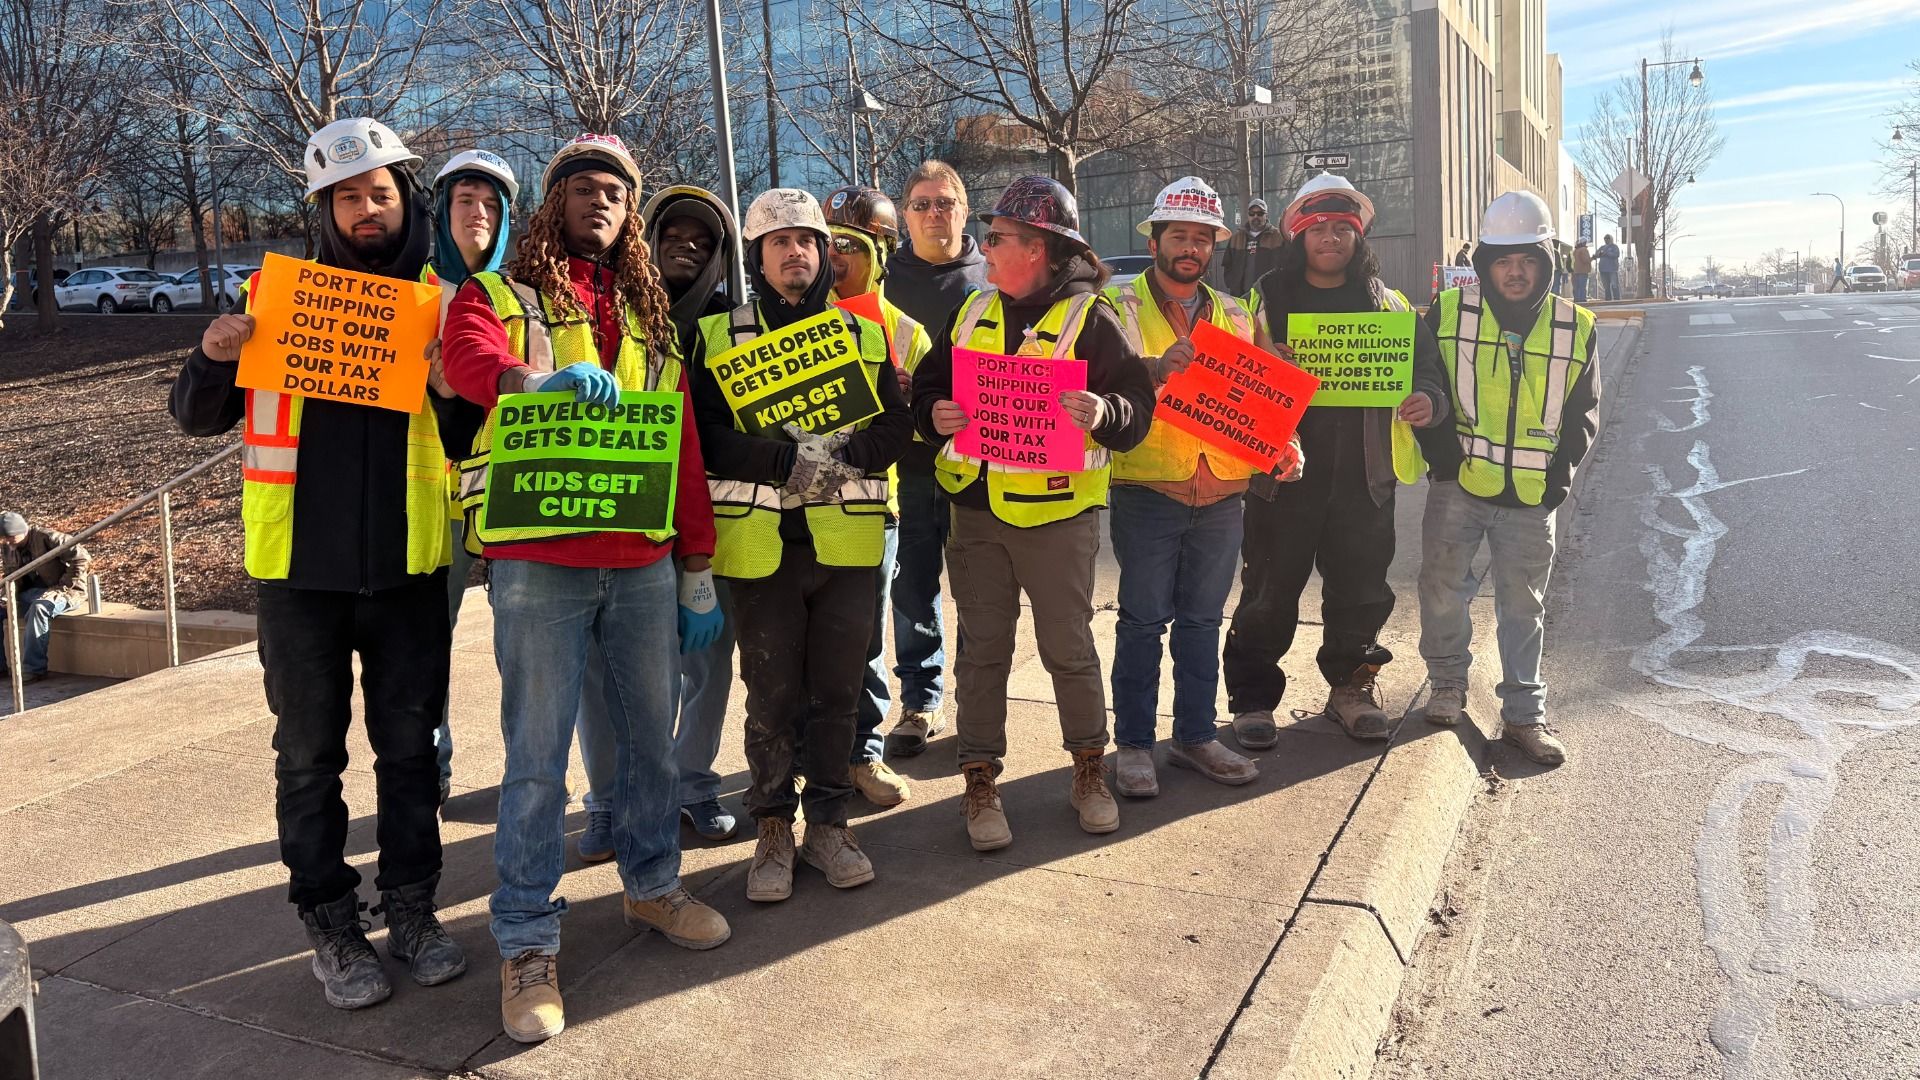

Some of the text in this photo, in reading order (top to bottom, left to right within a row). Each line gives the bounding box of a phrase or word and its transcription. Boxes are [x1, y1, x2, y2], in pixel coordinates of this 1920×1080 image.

[1250, 106, 1264, 117] W.
[1266, 104, 1292, 116] Davis
[1180, 188, 1206, 196] PROUD
[298, 268, 399, 301] PORT KC:
[293, 290, 396, 321] SHIPPING
[292, 312, 390, 342] OUT OUR
[1317, 324, 1382, 335] PORT KC:
[276, 331, 397, 364] JOBS WITH
[715, 318, 844, 382] DEVELOPERS
[1290, 338, 1411, 349] TAKING MILLIONS
[285, 353, 382, 381] OUR TAX
[731, 339, 848, 398] GETS DEALS
[977, 357, 1050, 377] PORT KC:
[1234, 353, 1270, 378] TAX
[1335, 353, 1355, 363] KC
[1358, 352, 1409, 363] GIVING
[1194, 352, 1295, 409] ABATEMENTS
[1334, 366, 1372, 378] JOBS
[1374, 366, 1394, 377] TO
[283, 374, 380, 401] DOLLARS
[977, 375, 1050, 395] SHIPPING
[1372, 381, 1403, 391] ELSE
[500, 401, 677, 427] DEVELOPERS
[755, 377, 847, 428] KIDS GET
[979, 392, 1048, 413] OUT OUR
[1196, 392, 1258, 431] SCHOOL
[972, 408, 1056, 431] JOBS WITH
[1161, 394, 1279, 458] ABANDONMENT
[504, 427, 668, 450] GETS DEALS
[980, 426, 1046, 448] OUR TAX
[981, 443, 1048, 465] DOLLARS
[513, 471, 643, 494] KIDS GET
[539, 496, 617, 519] CUTS
